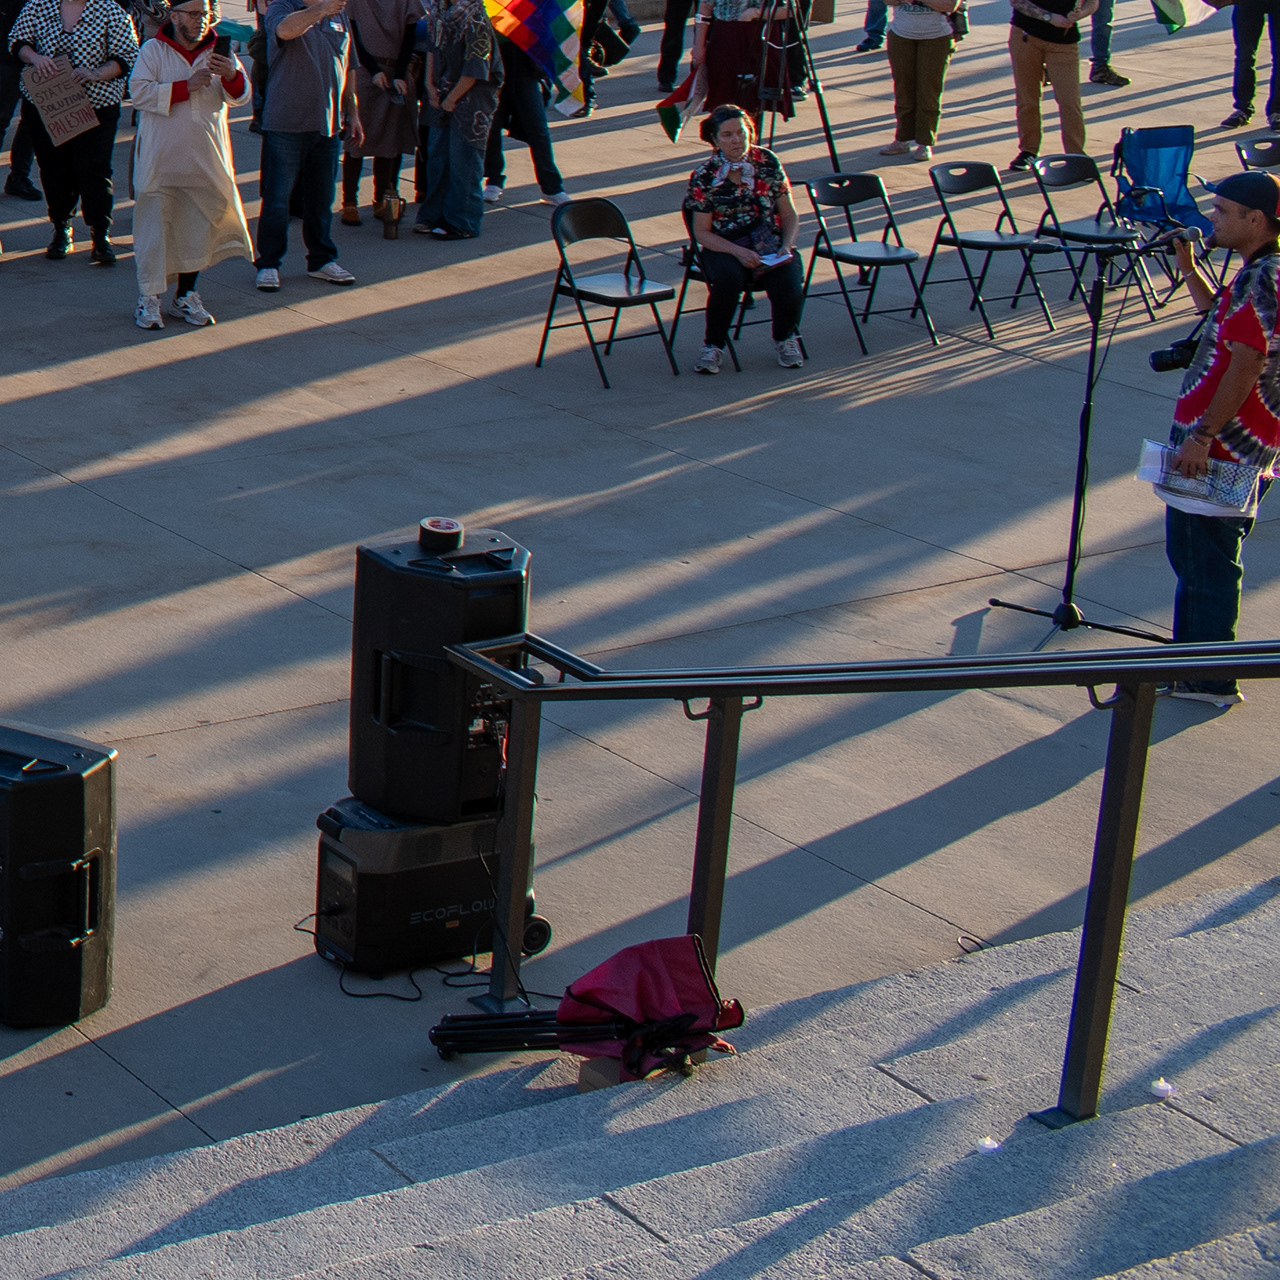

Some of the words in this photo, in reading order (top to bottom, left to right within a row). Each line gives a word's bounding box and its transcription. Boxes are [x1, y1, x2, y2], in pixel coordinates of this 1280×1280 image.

[31, 60, 66, 84] OE
[35, 80, 74, 104] STATE
[41, 91, 86, 116] SOLUTION
